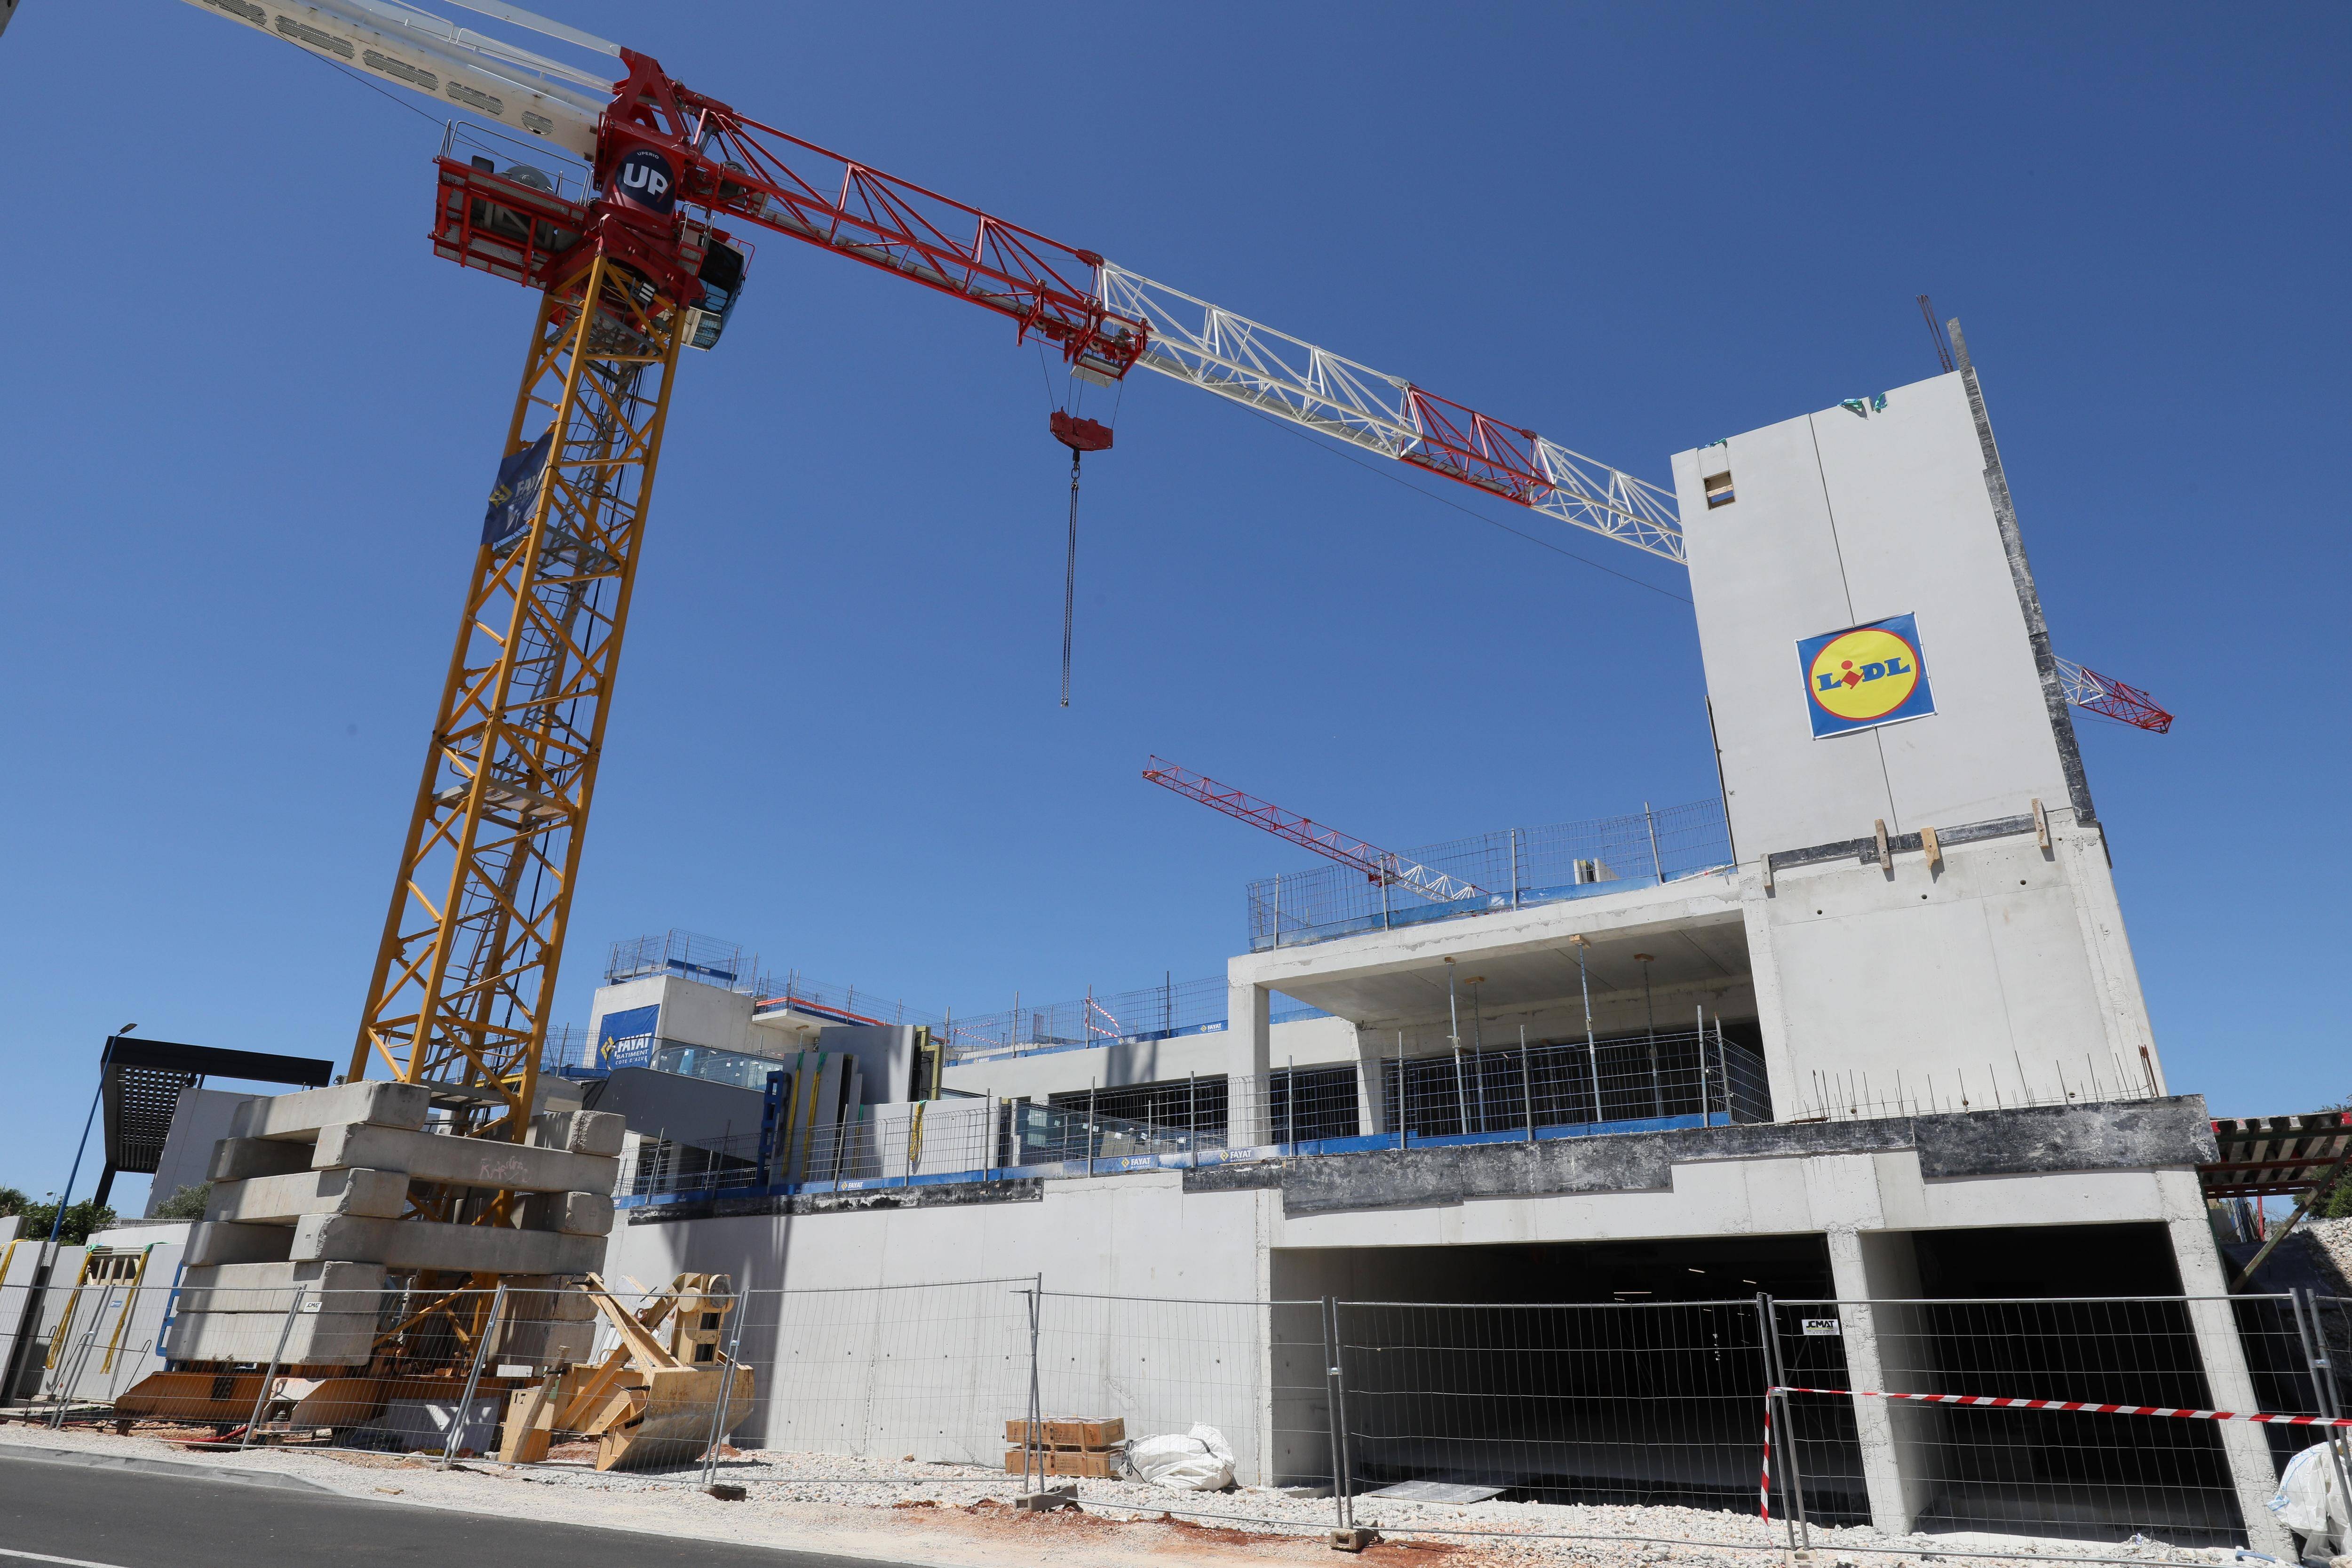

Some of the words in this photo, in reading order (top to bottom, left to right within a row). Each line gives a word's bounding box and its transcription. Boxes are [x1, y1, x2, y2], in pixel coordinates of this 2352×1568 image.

[623, 163, 668, 195] UP
[618, 1032, 652, 1053] FAYAT
[616, 1049, 649, 1059] BATIMENT
[1230, 1150, 1251, 1159] FAYAT
[1131, 1157, 1151, 1166] FAYAT
[514, 1393, 526, 1404] 17
